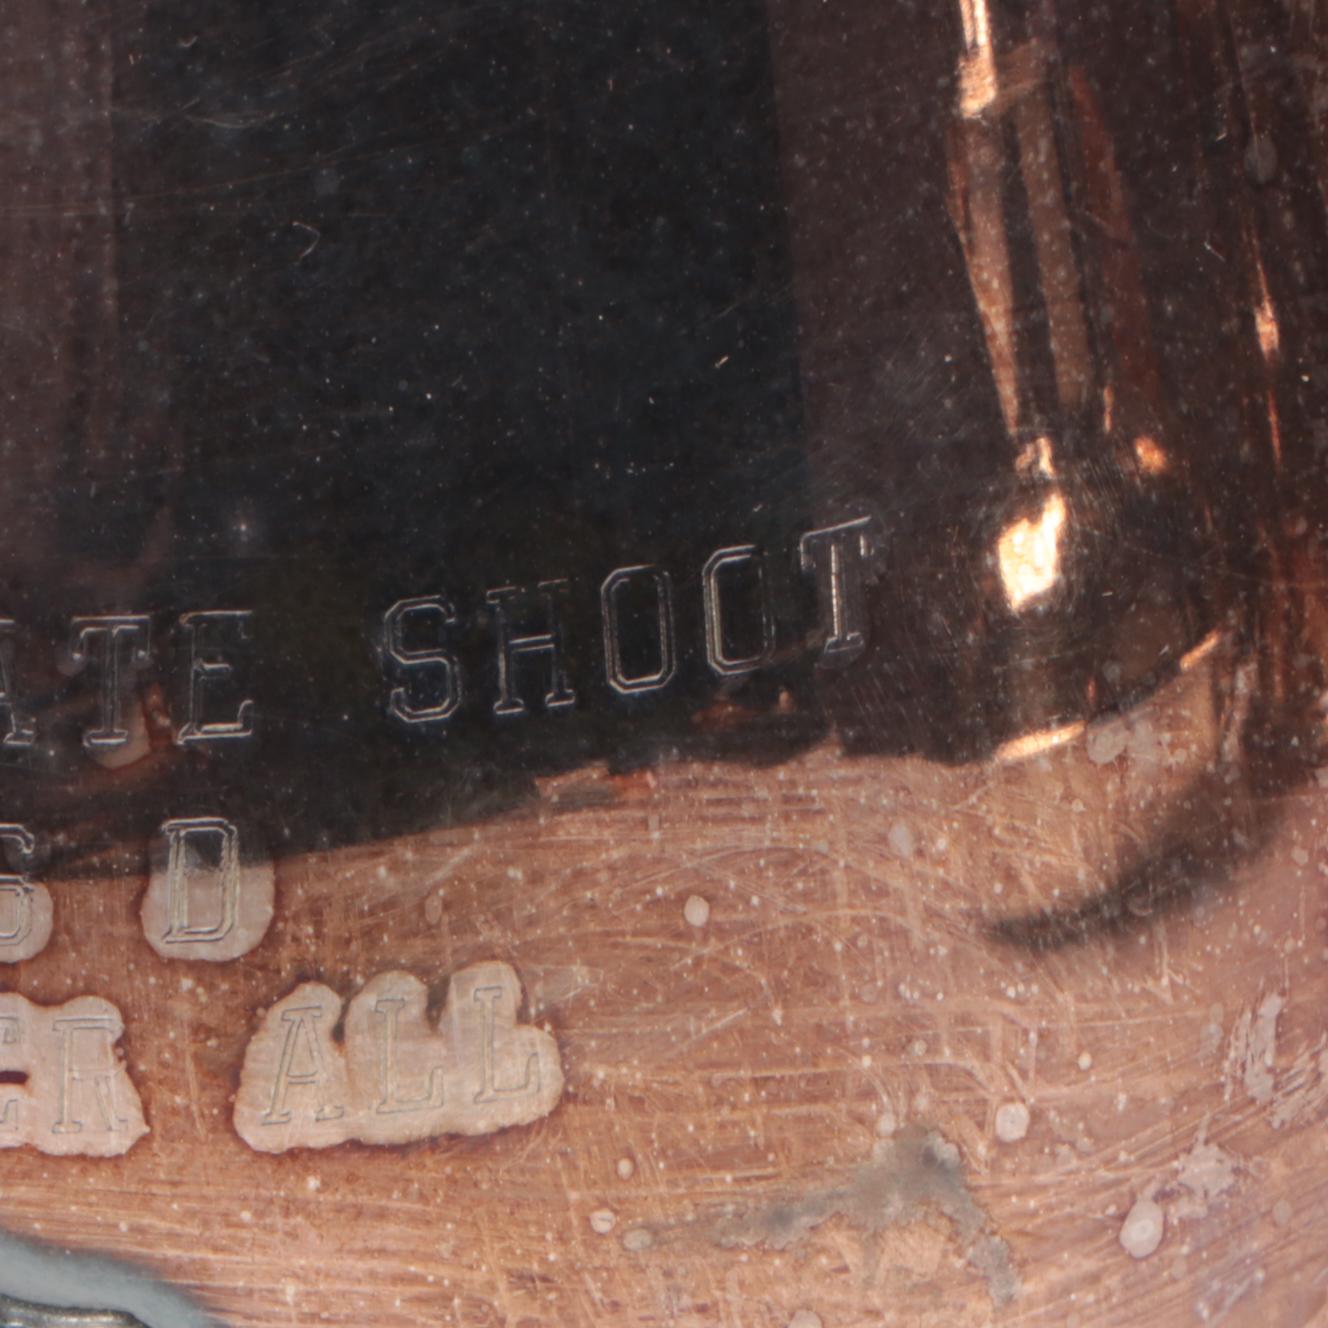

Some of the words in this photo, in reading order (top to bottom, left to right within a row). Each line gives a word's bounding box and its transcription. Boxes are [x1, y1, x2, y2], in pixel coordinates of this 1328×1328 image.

[381, 515, 874, 724] SHOOT
[161, 817, 239, 943] D
[259, 985, 545, 1126] ALL
